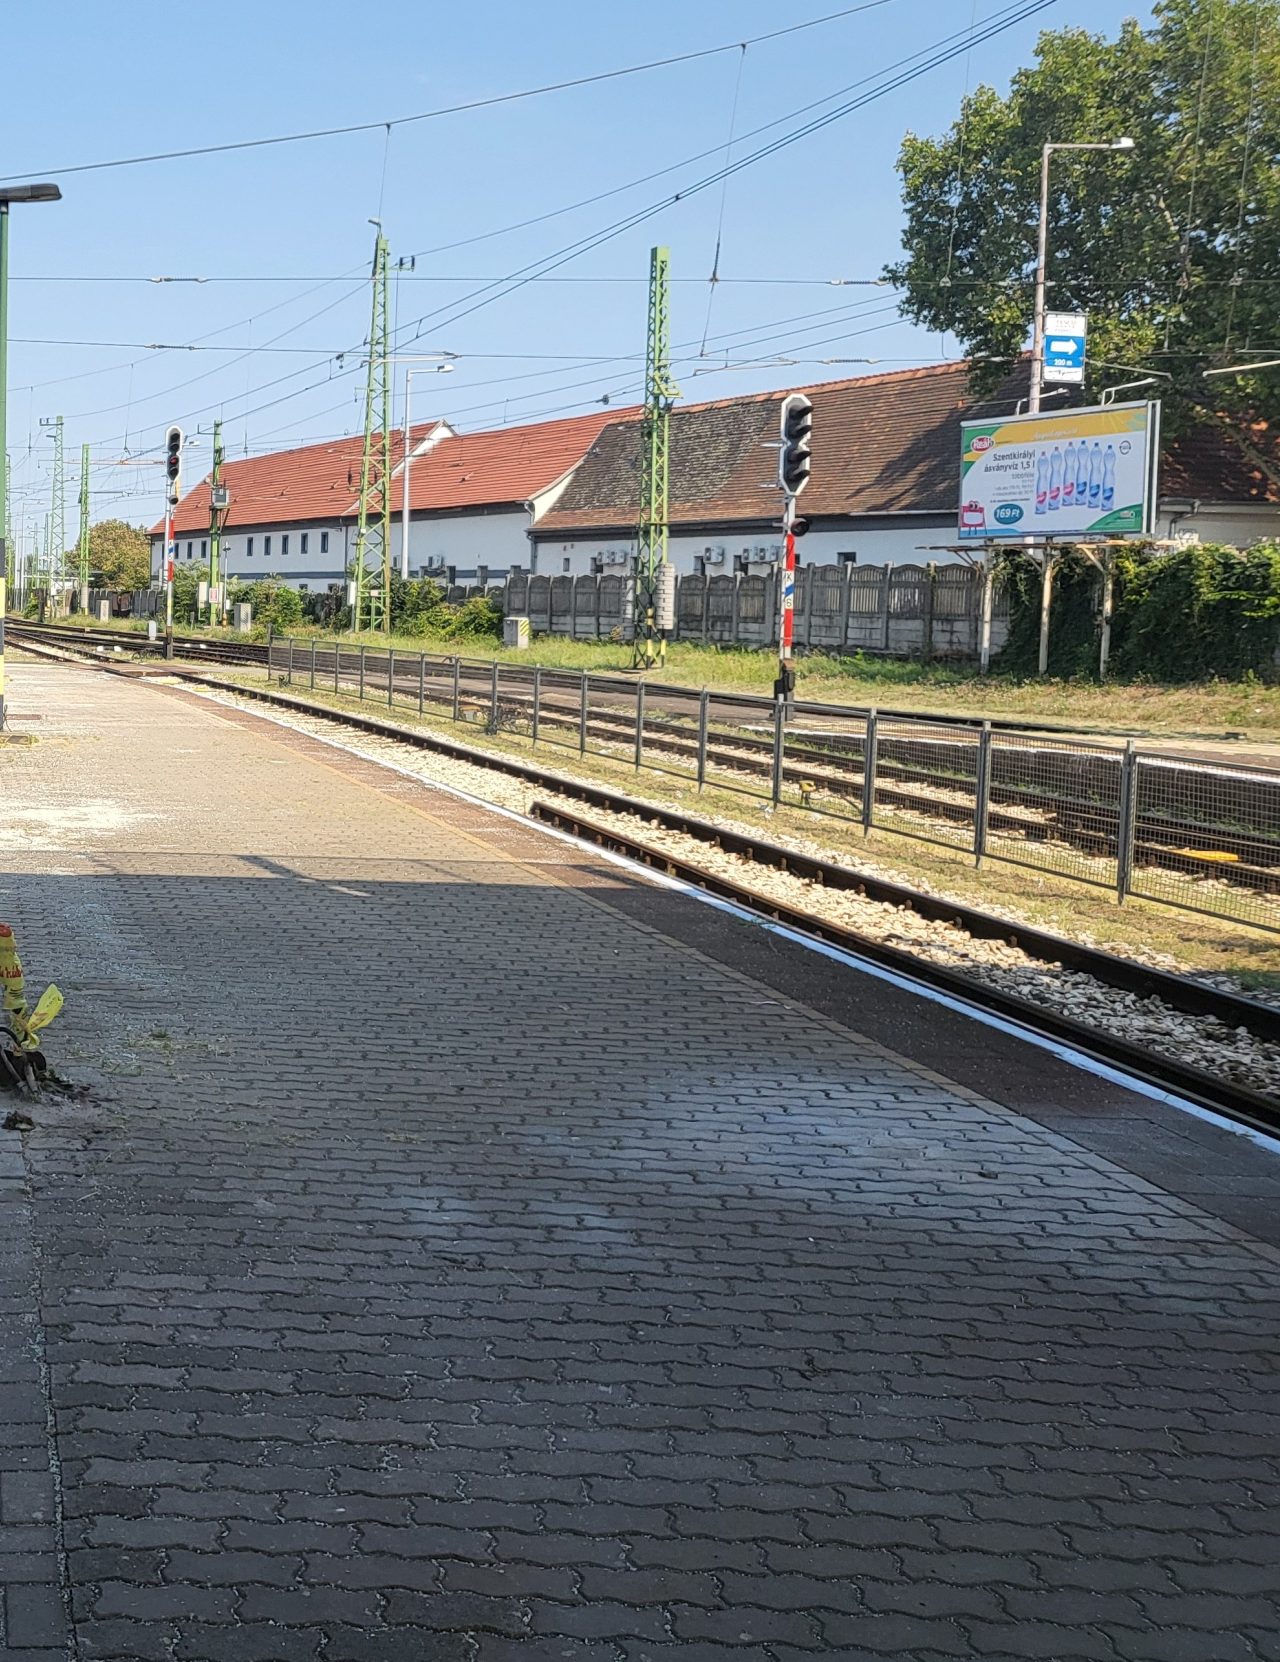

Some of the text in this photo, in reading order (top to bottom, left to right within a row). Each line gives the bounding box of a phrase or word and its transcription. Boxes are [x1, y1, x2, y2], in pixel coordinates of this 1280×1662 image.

[993, 449, 1035, 461] Szentkirályi
[1021, 460, 1031, 470] 1,5
[996, 508, 1020, 518] 169 Ft
[786, 573, 792, 582] K
